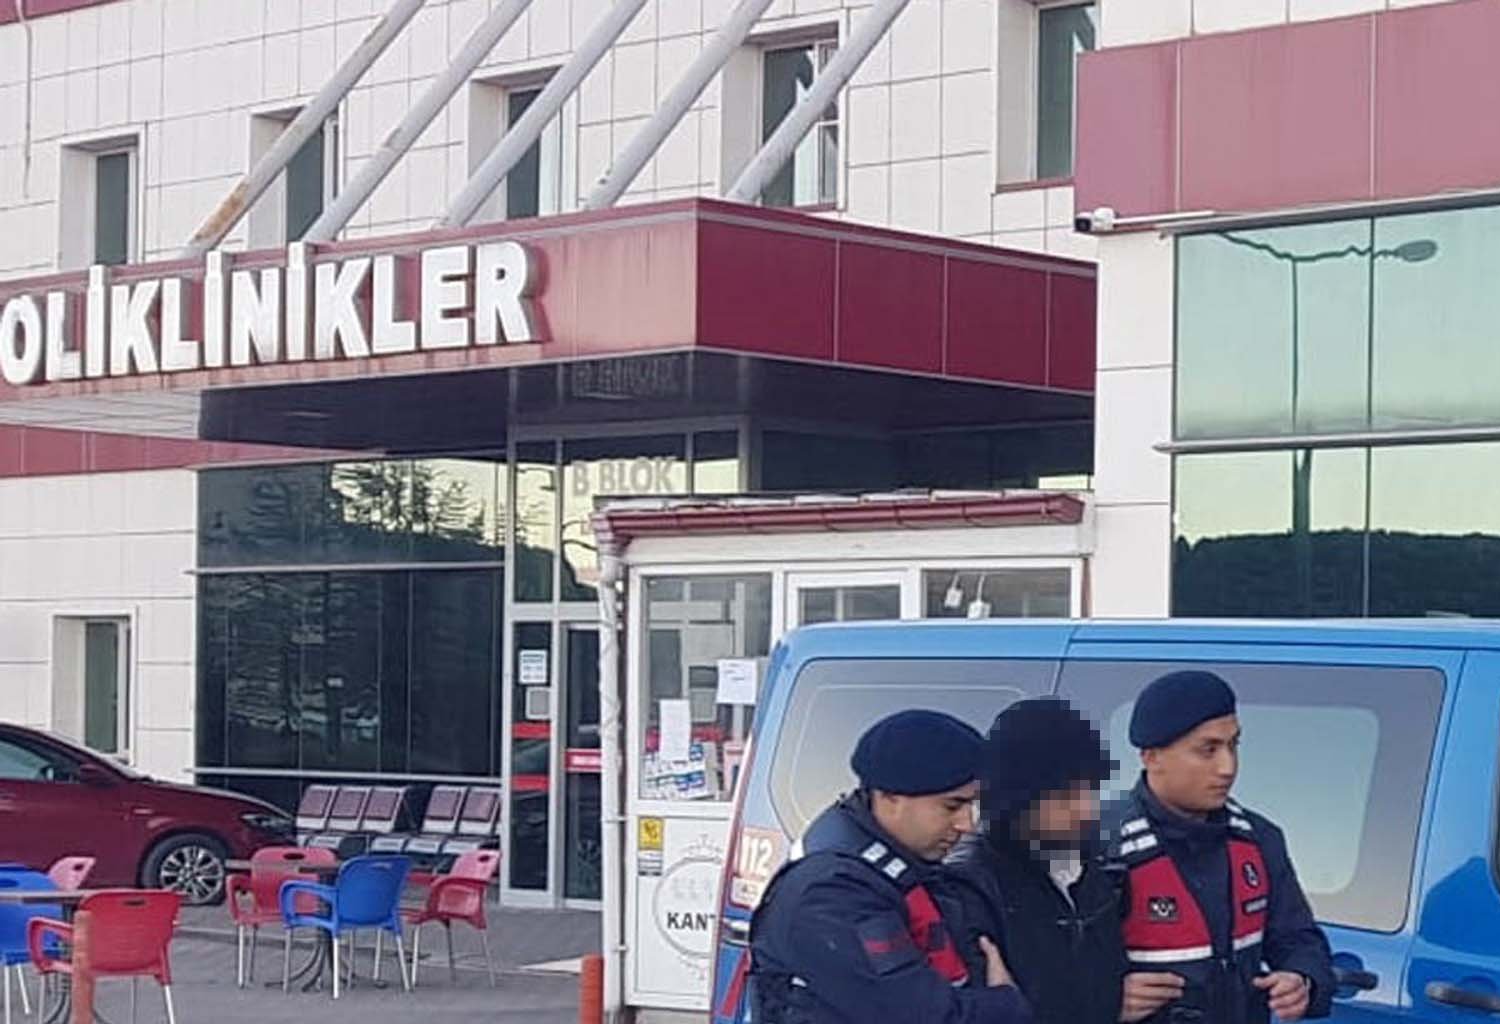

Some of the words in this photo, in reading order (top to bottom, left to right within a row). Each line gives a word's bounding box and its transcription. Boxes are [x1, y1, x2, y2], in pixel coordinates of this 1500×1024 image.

[572, 459, 590, 497] B
[600, 455, 677, 493] BLOK
[740, 833, 773, 876] 112
